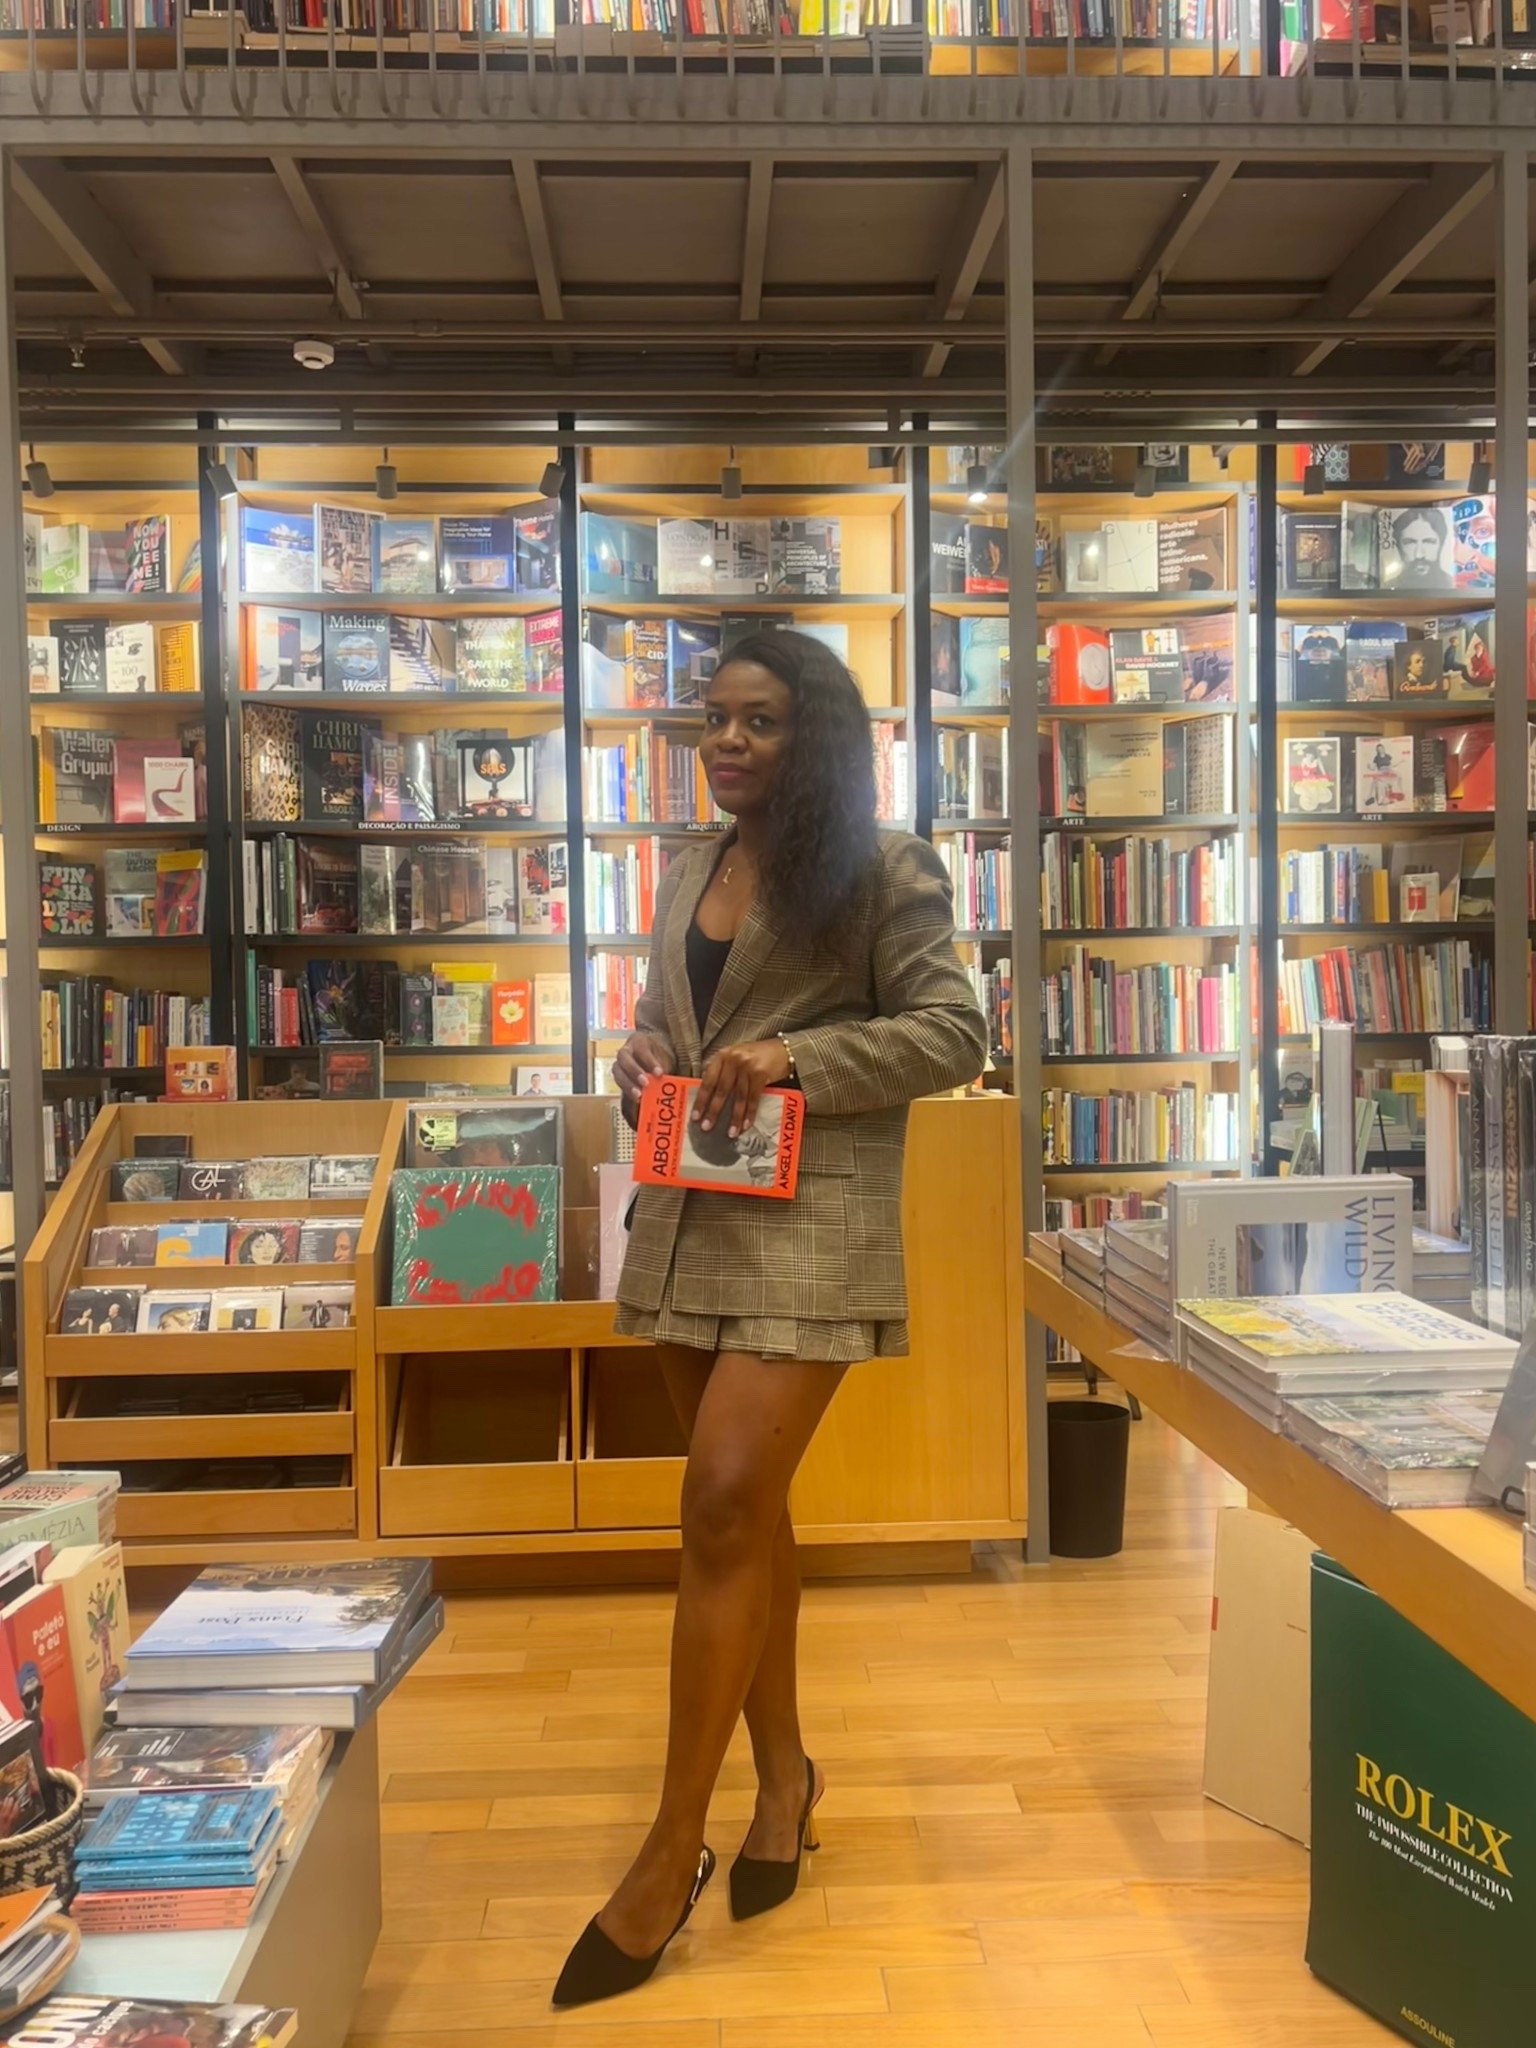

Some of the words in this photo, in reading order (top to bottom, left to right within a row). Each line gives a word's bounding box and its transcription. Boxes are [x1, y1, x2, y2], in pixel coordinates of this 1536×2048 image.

[133, 524, 161, 539] NOW
[1160, 519, 1199, 531] Mulheres
[133, 537, 160, 552] YOU
[1160, 540, 1178, 549] arte
[133, 563, 160, 579] ME!
[329, 615, 386, 632] Making
[121, 665, 138, 676] 100
[342, 679, 388, 692] Waves
[473, 678, 509, 688] WORLD
[60, 729, 115, 754] Walter
[383, 748, 399, 804] INSIDE
[46, 824, 81, 832] DESIGN
[358, 821, 406, 831] DECORAÇÃO
[1062, 818, 1085, 826] ARTE
[417, 845, 449, 853] Chinese
[451, 845, 480, 853] Houses
[41, 866, 86, 884] FUN
[62, 884, 93, 901] KA
[42, 900, 70, 917] DE
[60, 919, 94, 935] LIC
[785, 1097, 798, 1131] DAVIS
[1471, 1097, 1481, 1132] ANA
[652, 1082, 677, 1177] ABOLIÇÃO
[778, 1145, 793, 1190] ANGELA
[1472, 1138, 1482, 1196] MARIA
[1488, 1122, 1502, 1287] PASSARELLI
[1344, 1196, 1368, 1279] WILD
[1473, 1199, 1483, 1257] VIEIRA
[1207, 1238, 1216, 1258] THE
[1218, 1247, 1227, 1272] NEW
[1207, 1261, 1216, 1296] GREAT
[1218, 1276, 1227, 1298] BEG
[1356, 1303, 1395, 1315] OF
[1378, 1315, 1449, 1340] PARIS
[1381, 1301, 1485, 1341] GARDENS
[32, 1611, 65, 1646] Paletó
[197, 1616, 242, 1624] Post
[248, 1615, 304, 1624] Frans
[38, 1643, 46, 1656] e
[46, 1632, 60, 1651] eu
[1356, 1753, 1514, 1878] ROLEX
[1355, 1802, 1376, 1824] THE
[1377, 1815, 1440, 1862] IMPOSSIBLE
[1440, 1853, 1513, 1903] COLLECTION
[1368, 1829, 1380, 1841] The
[1393, 1844, 1409, 1860] Most
[1408, 1854, 1448, 1883] Exceptional
[1448, 1876, 1470, 1896] Watch
[1471, 1890, 1496, 1911] Models
[1400, 2005, 1456, 2048] ASSOULINE
